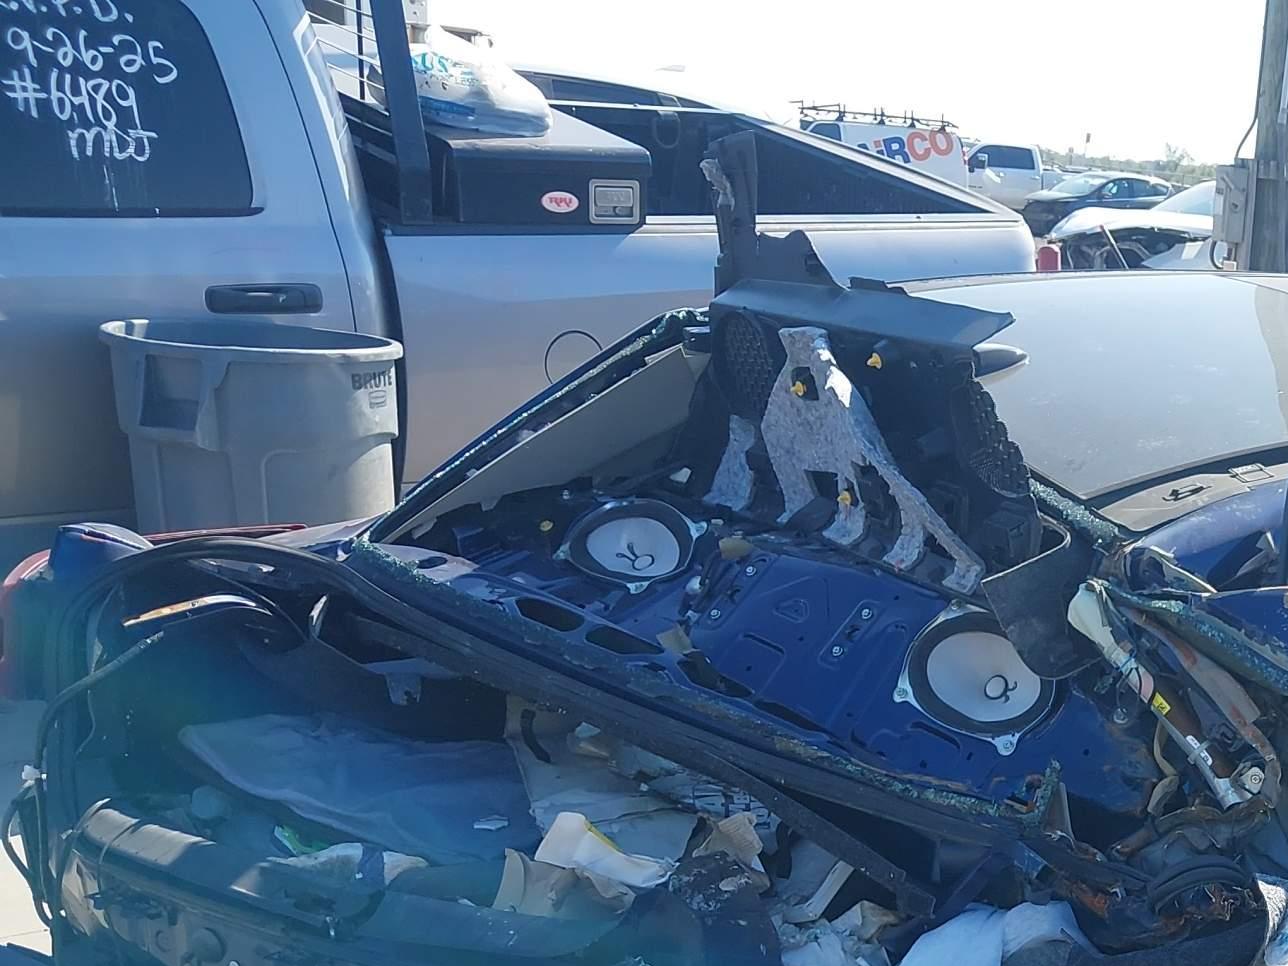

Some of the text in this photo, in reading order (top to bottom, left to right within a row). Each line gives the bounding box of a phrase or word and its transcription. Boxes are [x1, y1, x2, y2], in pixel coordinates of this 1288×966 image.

[7, 27, 178, 84] 9-26-25
[1, 65, 142, 131] #6489
[351, 369, 393, 391] BRUTE
